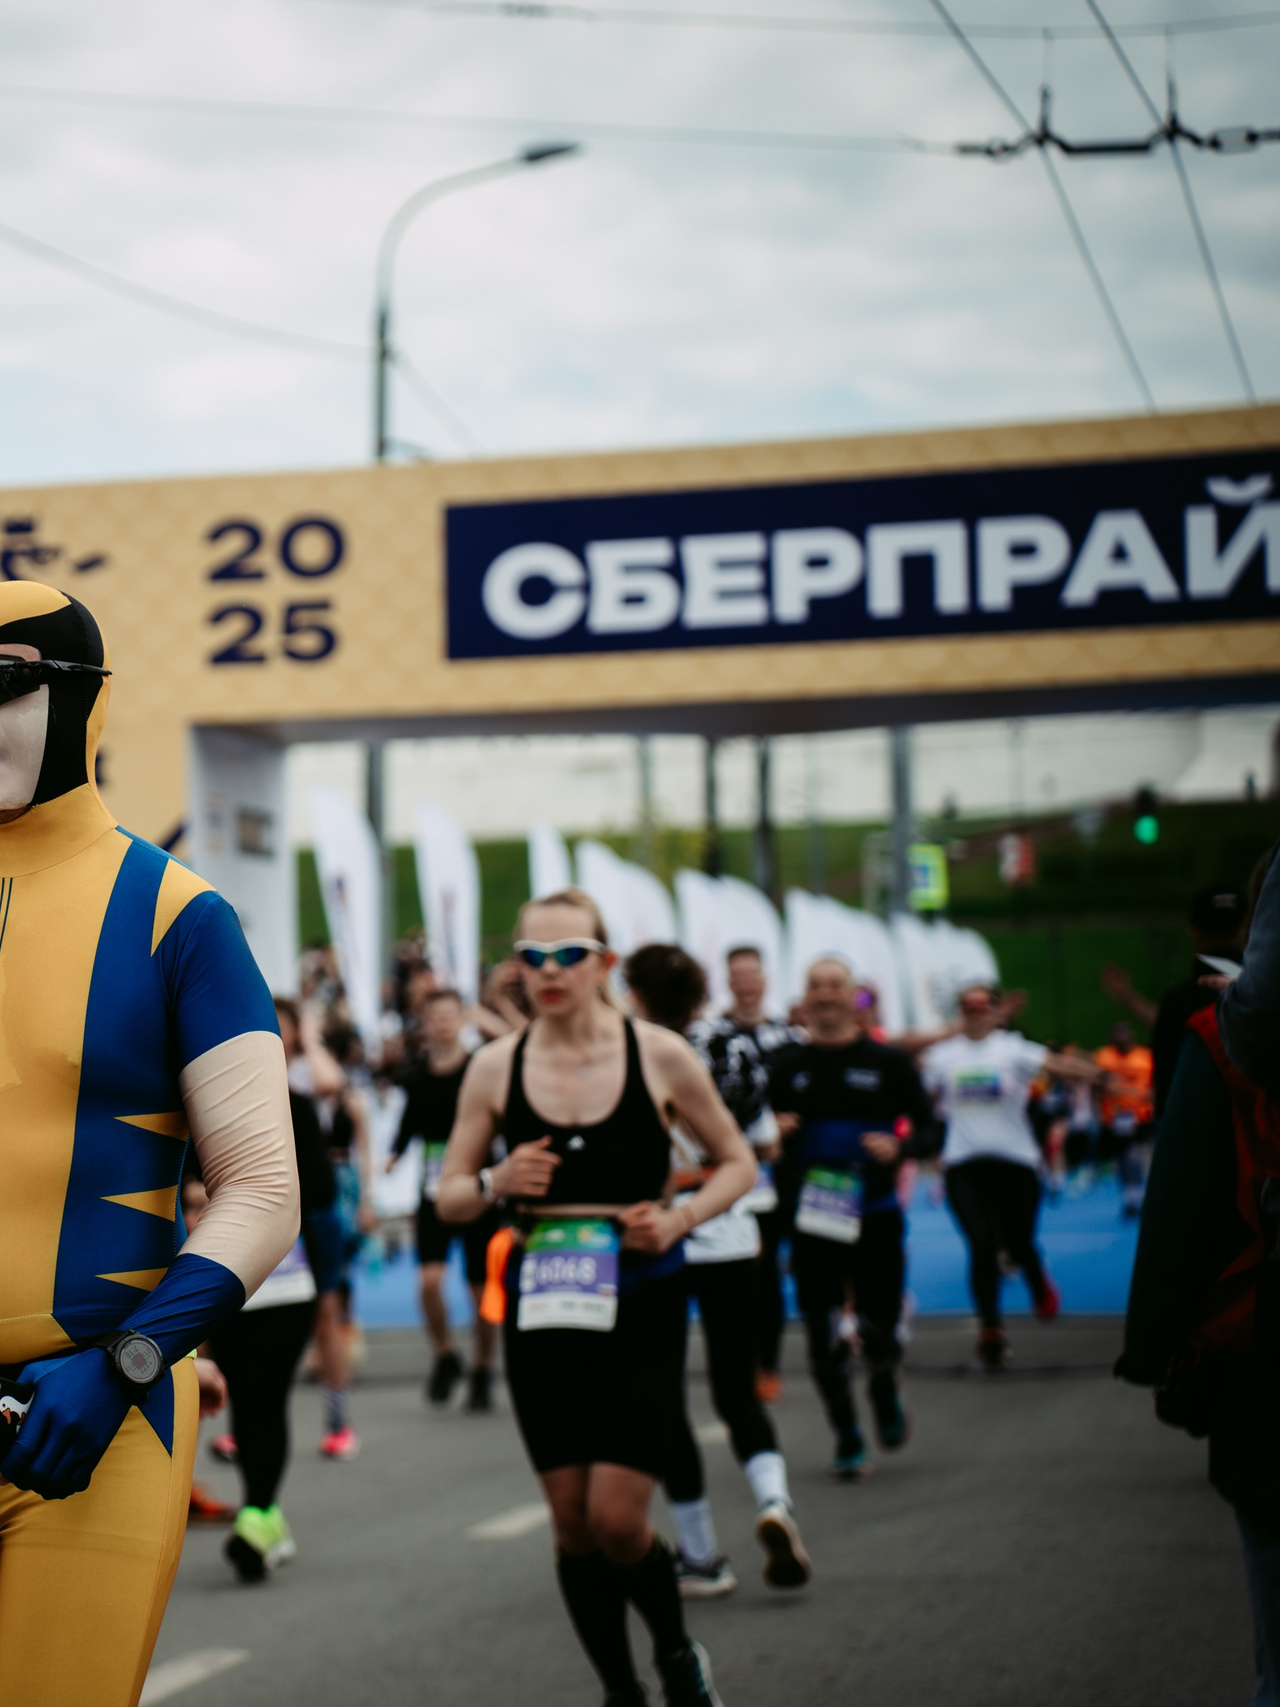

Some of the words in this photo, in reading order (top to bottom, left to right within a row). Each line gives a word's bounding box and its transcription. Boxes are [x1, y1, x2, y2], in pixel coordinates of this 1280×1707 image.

[205, 516, 347, 582] 20
[482, 473, 1280, 641] СБЕРПРАЙ
[207, 600, 339, 664] 25
